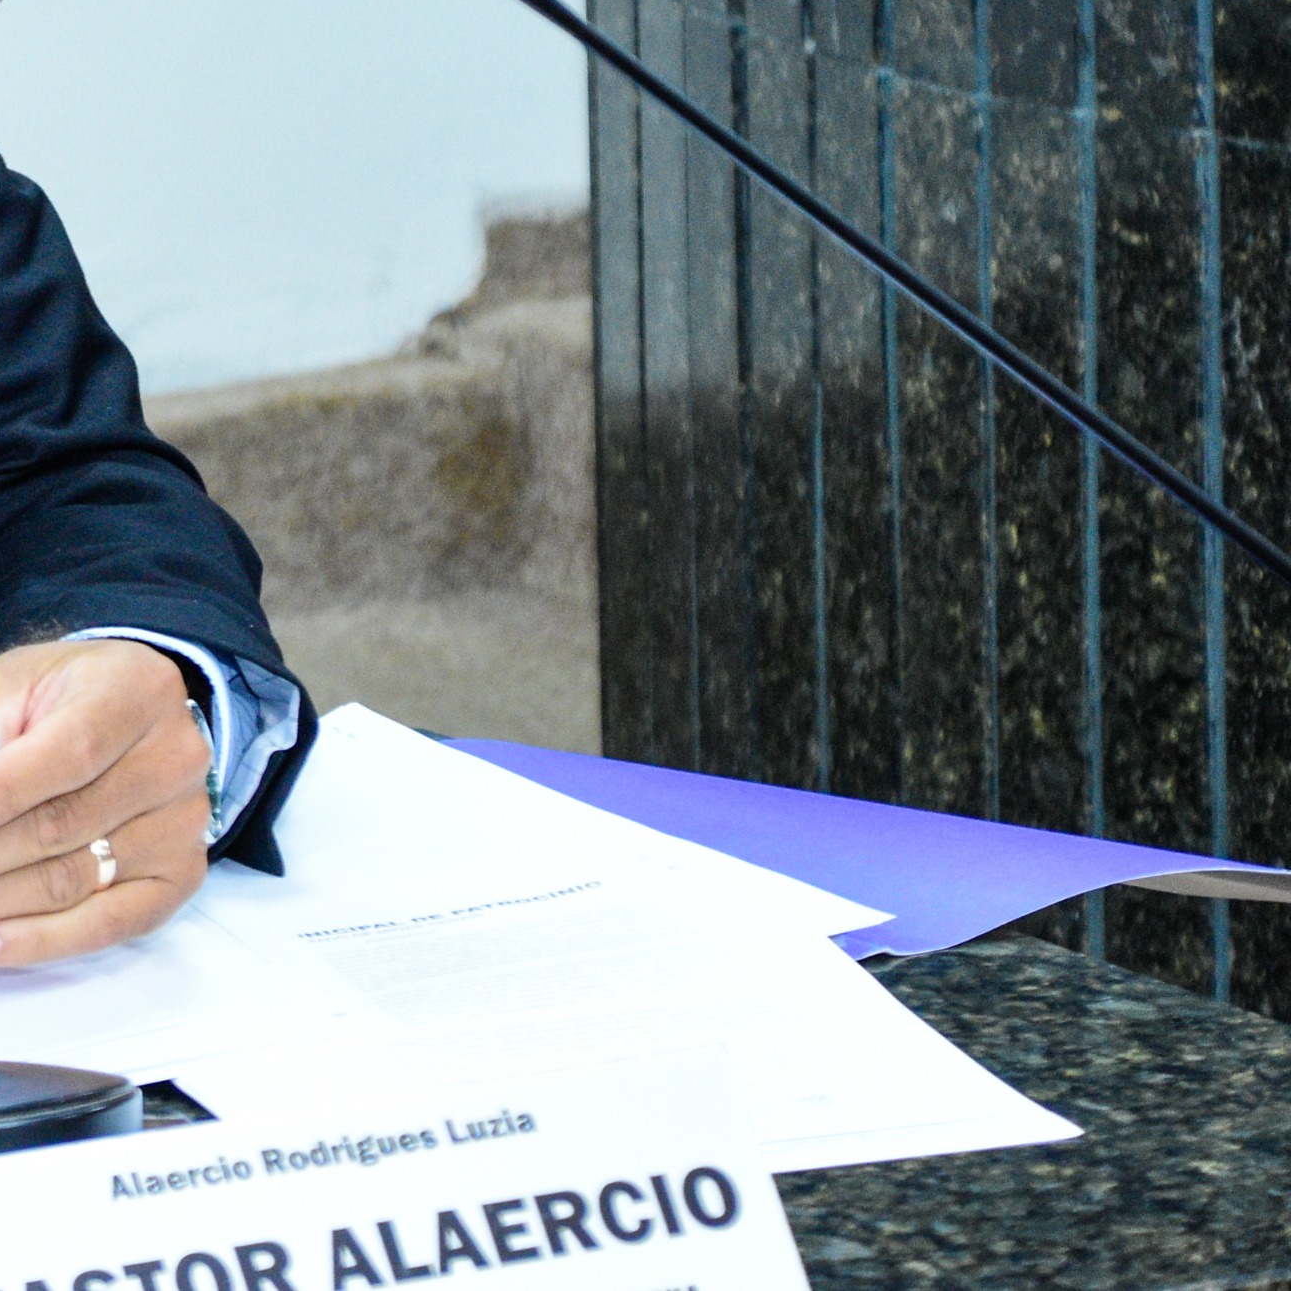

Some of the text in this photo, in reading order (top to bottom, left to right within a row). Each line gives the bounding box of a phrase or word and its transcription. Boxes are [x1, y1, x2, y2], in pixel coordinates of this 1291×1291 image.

[410, 913, 444, 924] DE
[450, 879, 604, 916] PATROCÍNIO
[111, 1109, 537, 1201] Alaercio Rodrigues Luzia
[331, 1166, 741, 1291] ALAERCIO
